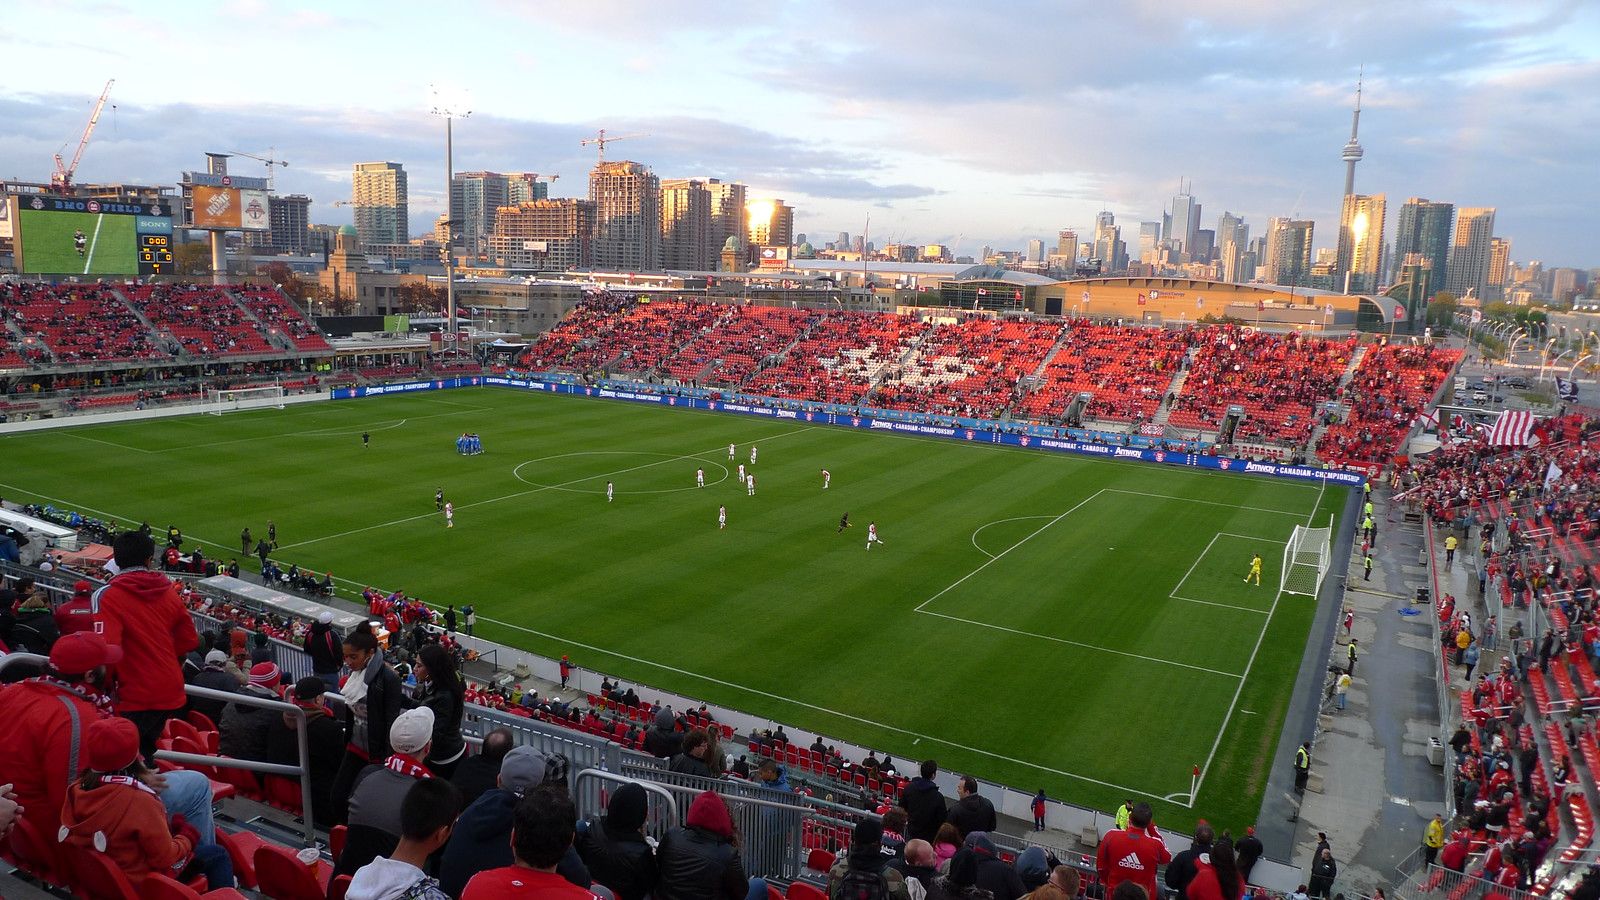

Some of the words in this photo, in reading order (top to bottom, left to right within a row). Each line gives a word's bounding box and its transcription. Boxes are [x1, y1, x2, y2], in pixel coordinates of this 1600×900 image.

[54, 200, 85, 211] BMO
[103, 203, 142, 213] FIELD
[206, 191, 230, 215] HOME
[140, 220, 168, 228] SONY
[366, 386, 385, 396] Amway
[599, 388, 616, 398] Amway
[776, 408, 797, 419] Amway
[871, 419, 893, 430] Amway
[895, 423, 918, 432] CANADIAN
[920, 425, 955, 436] CHAMPIONSHIP
[1041, 439, 1077, 450] CHAMPIONNAT
[1082, 444, 1109, 453] CANADIEN
[1114, 446, 1143, 458] Amway
[1245, 461, 1276, 474] Amway
[1279, 466, 1311, 477] CANADIAN
[1118, 860, 1145, 870] adidas
